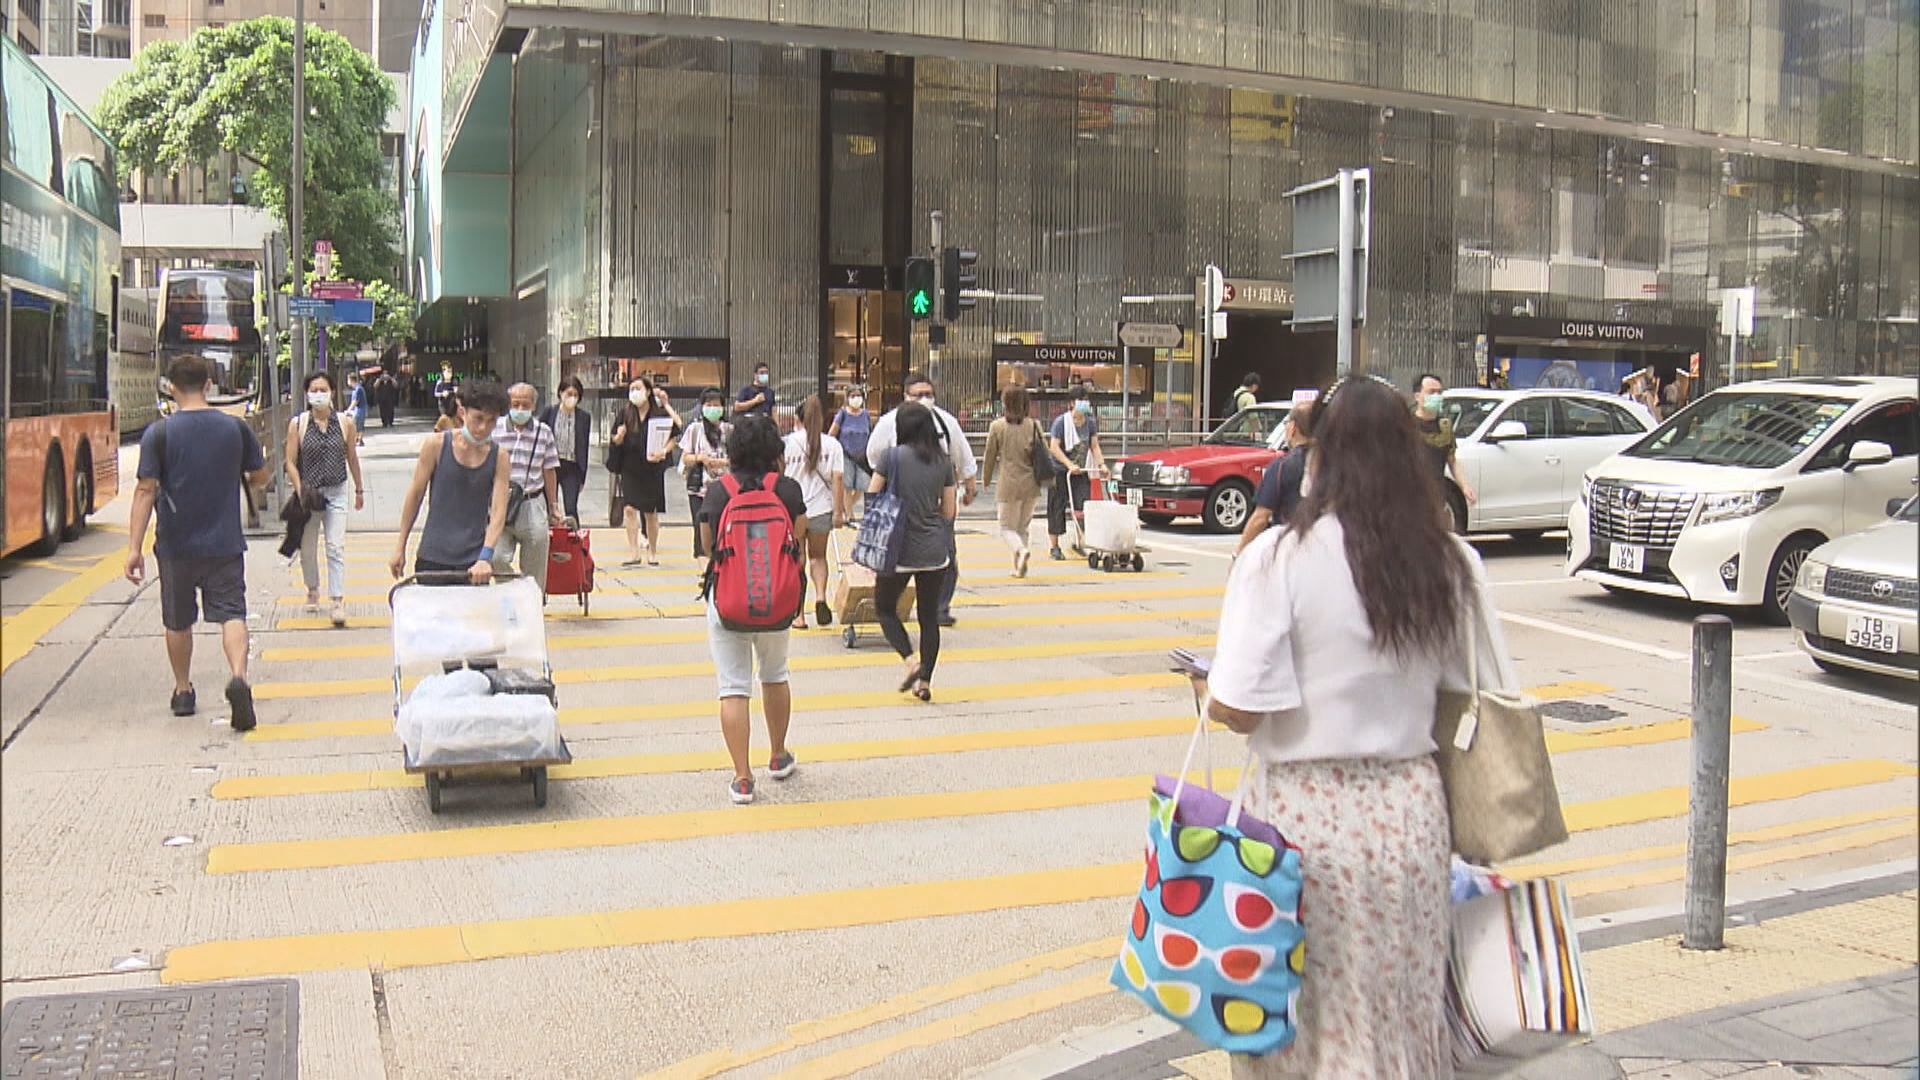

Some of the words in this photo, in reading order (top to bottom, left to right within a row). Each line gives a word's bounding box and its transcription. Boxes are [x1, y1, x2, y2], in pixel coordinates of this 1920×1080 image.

[1243, 286, 1287, 304] 中環站
[1561, 322, 1594, 337] LOUIS
[1597, 325, 1644, 339] VUITTON
[1035, 348, 1067, 360] LOUIS
[1070, 350, 1116, 361] VUITTON
[1620, 545, 1634, 558] VN
[1616, 556, 1634, 569] 184
[1863, 616, 1883, 633] TB
[1850, 630, 1893, 649] 3928
